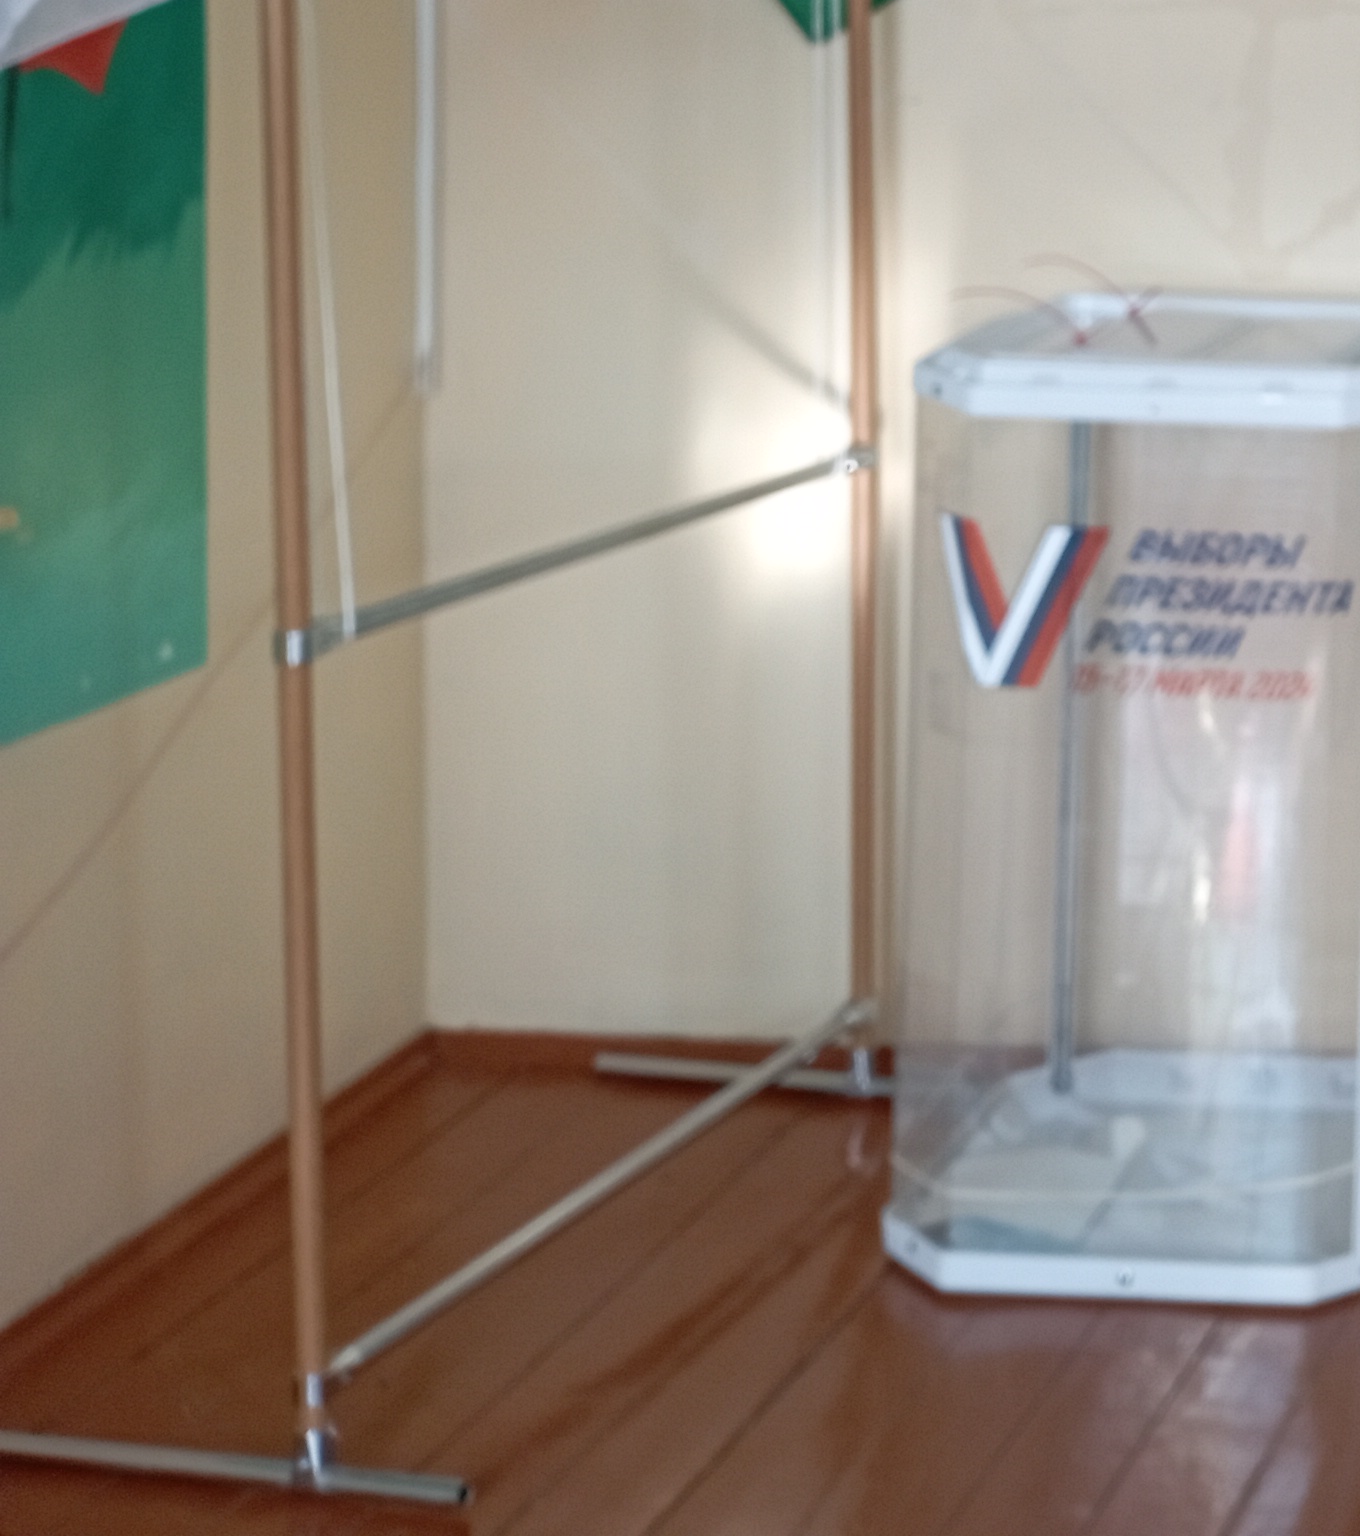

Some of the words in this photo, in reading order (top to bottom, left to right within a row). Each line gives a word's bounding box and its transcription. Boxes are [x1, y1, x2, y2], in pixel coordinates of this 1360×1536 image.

[1129, 527, 1307, 568] ВЫБОРЫ
[1105, 573, 1356, 619] ПРЕЗИДЕНТА
[1085, 618, 1247, 659] РОССИИ
